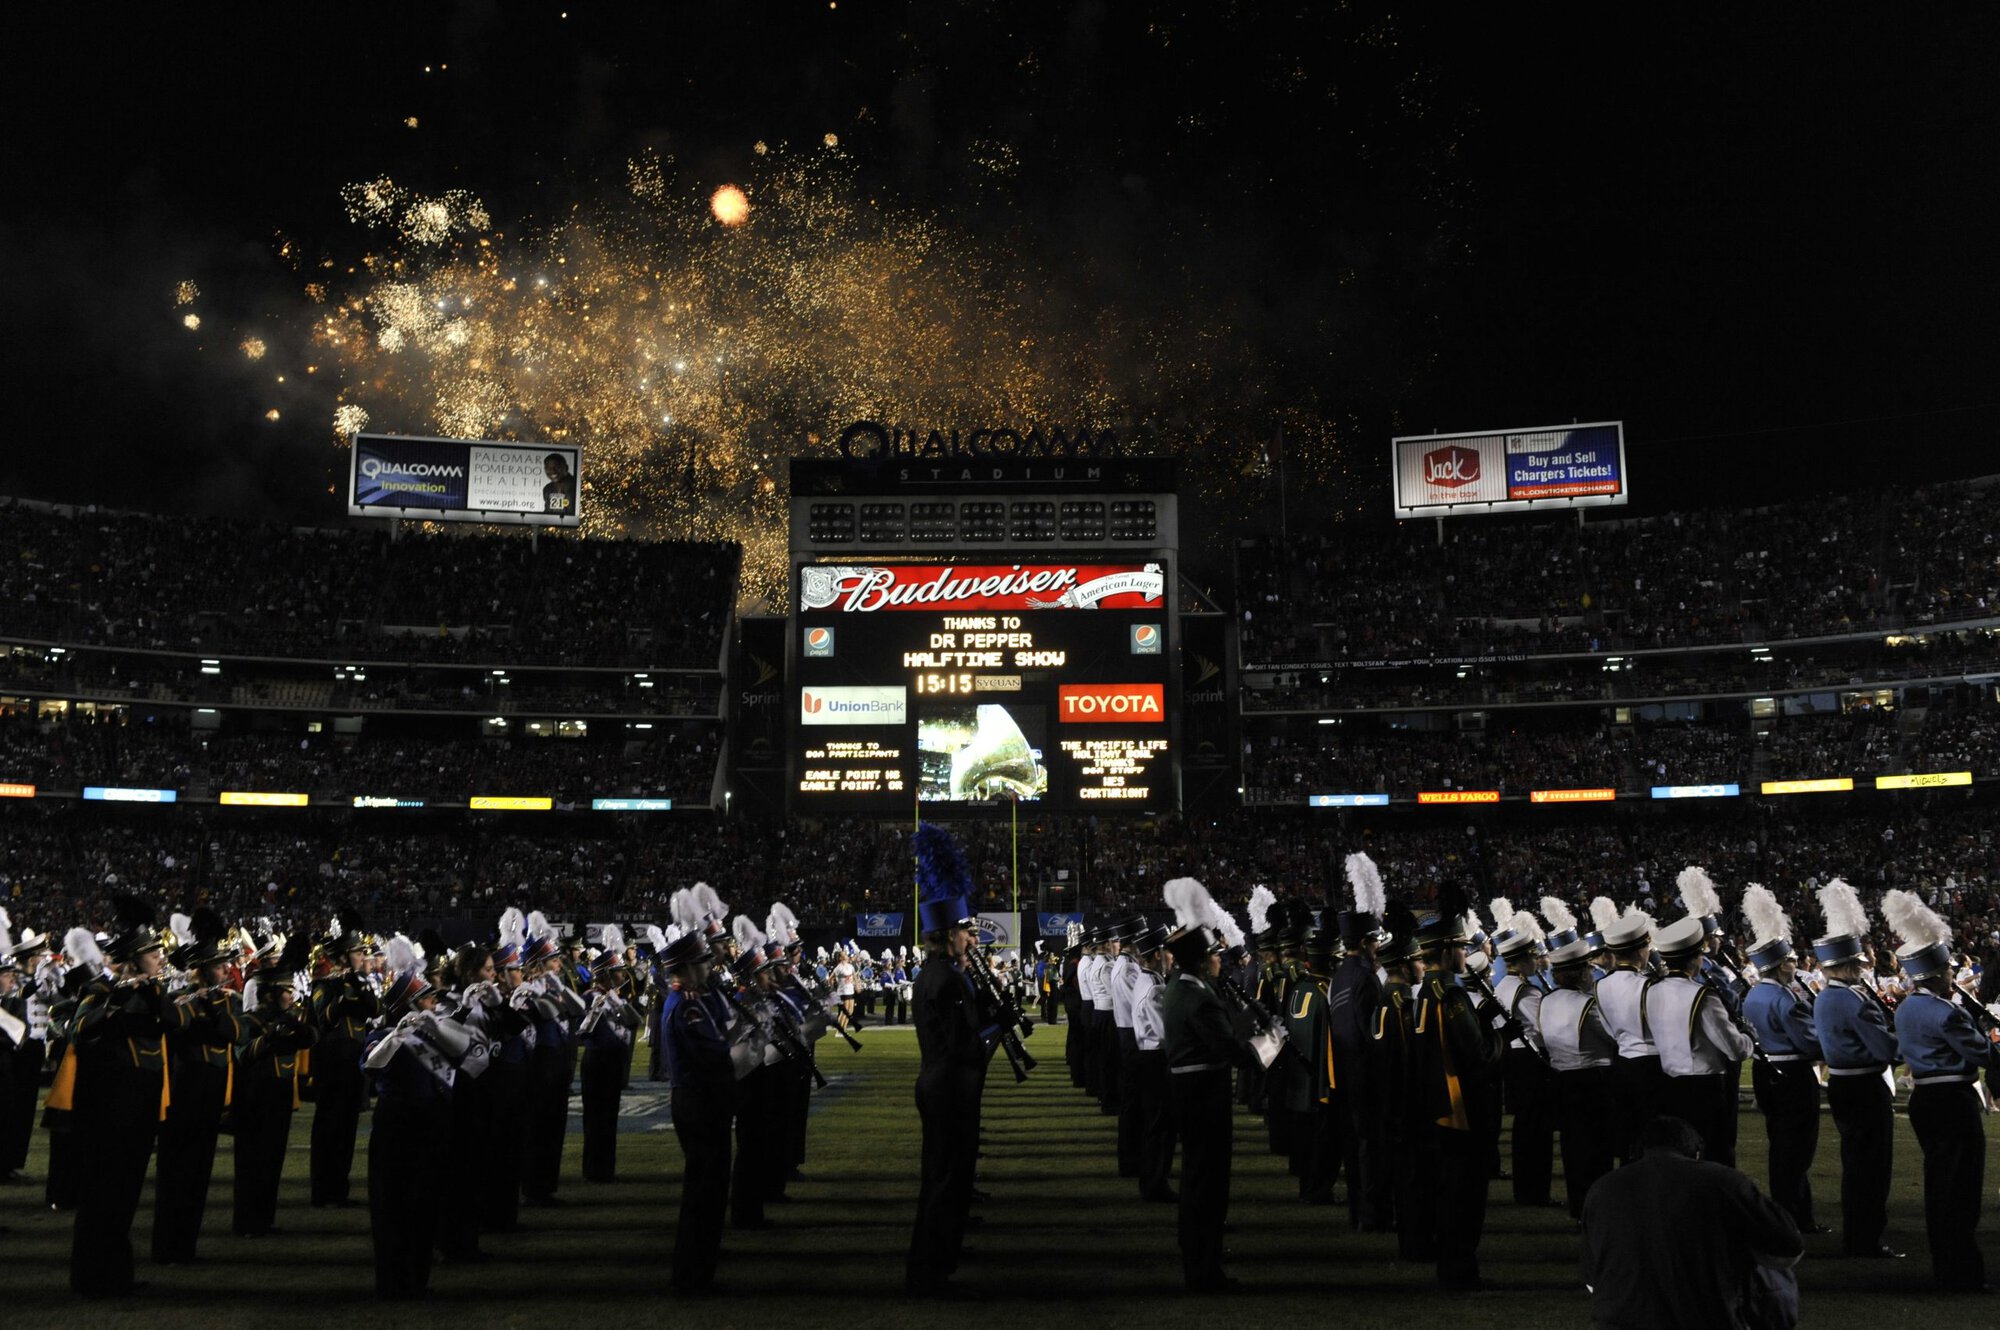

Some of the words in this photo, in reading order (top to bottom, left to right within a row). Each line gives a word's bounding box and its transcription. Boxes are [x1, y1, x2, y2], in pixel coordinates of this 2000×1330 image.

[840, 420, 1120, 479] QUALCOMM
[474, 452, 542, 465] PALOMAR
[1528, 454, 1548, 468] Buy
[1551, 453, 1572, 465] and
[1575, 451, 1596, 463] Sell
[361, 458, 464, 480] QUALCOMM
[474, 464, 542, 477] POMERADO
[1426, 450, 1479, 482] Jack
[899, 467, 1100, 481] STADIUM
[1514, 467, 1565, 483] Chargers
[1567, 464, 1612, 478] Tickets!
[381, 481, 446, 494] Innovation
[474, 475, 542, 488] HEALTH
[1429, 492, 1438, 500] in
[1441, 491, 1456, 500] the
[1460, 490, 1478, 499] box
[478, 498, 535, 510] www.pph.org
[833, 565, 1078, 612] Budweiser
[1080, 580, 1127, 602] American
[1130, 578, 1160, 589] Lager
[943, 617, 996, 630] THANKS
[1001, 616, 1021, 630] TO
[930, 633, 956, 648] DR
[963, 633, 1033, 648] PEPPER
[1137, 646, 1156, 654] pepsi
[903, 652, 1003, 667] HALFTIME
[1015, 651, 1066, 666] SHOW
[917, 674, 972, 693] 15:15
[742, 691, 781, 707] Sprint
[1064, 695, 1159, 713] TOYOTA
[828, 701, 904, 712] UnionBank
[867, 742, 880, 750] TO
[1060, 741, 1082, 750] THE
[1086, 741, 1135, 750] PACIFIC
[1139, 740, 1168, 750] LIFE
[829, 750, 900, 758] PARTICIPANTS
[1072, 750, 1121, 759] HOLIDAY
[1126, 750, 1154, 759] BOWL
[1093, 758, 1135, 767] THANKS
[805, 770, 841, 780] EAGLE
[846, 770, 881, 780] POINT
[1109, 766, 1145, 774] STAFF
[800, 781, 836, 791] EAGLE
[841, 781, 881, 790] POINT,
[888, 781, 903, 790] OR
[1102, 776, 1125, 787] WES
[1080, 788, 1149, 799] CARTWRIGHT
[1420, 792, 1458, 802] WELLS
[1460, 792, 1498, 802] FARGO
[857, 927, 888, 937] PACIFIC
